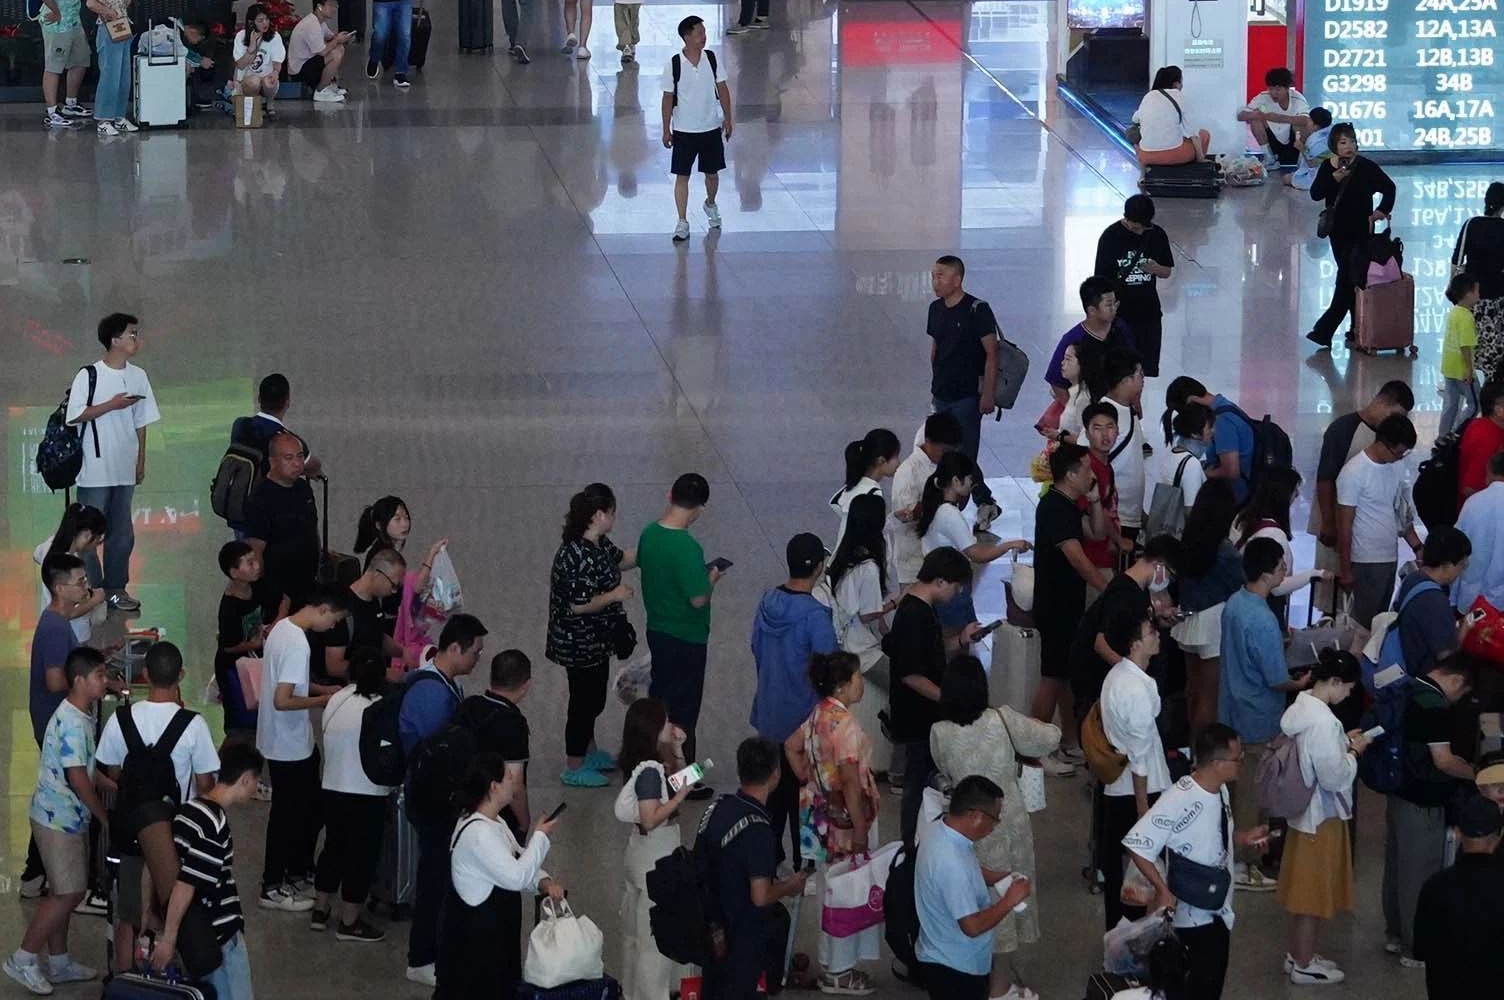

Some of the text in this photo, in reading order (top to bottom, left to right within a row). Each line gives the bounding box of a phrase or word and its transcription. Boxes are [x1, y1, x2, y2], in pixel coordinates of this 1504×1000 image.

[1324, 20, 1497, 41] D2582 12A,13A
[1323, 48, 1494, 68] D2721 12B,13B
[1322, 74, 1473, 93] G3298 34B
[1413, 100, 1495, 121] 16A,17A
[1413, 128, 1492, 149] 24B,25B
